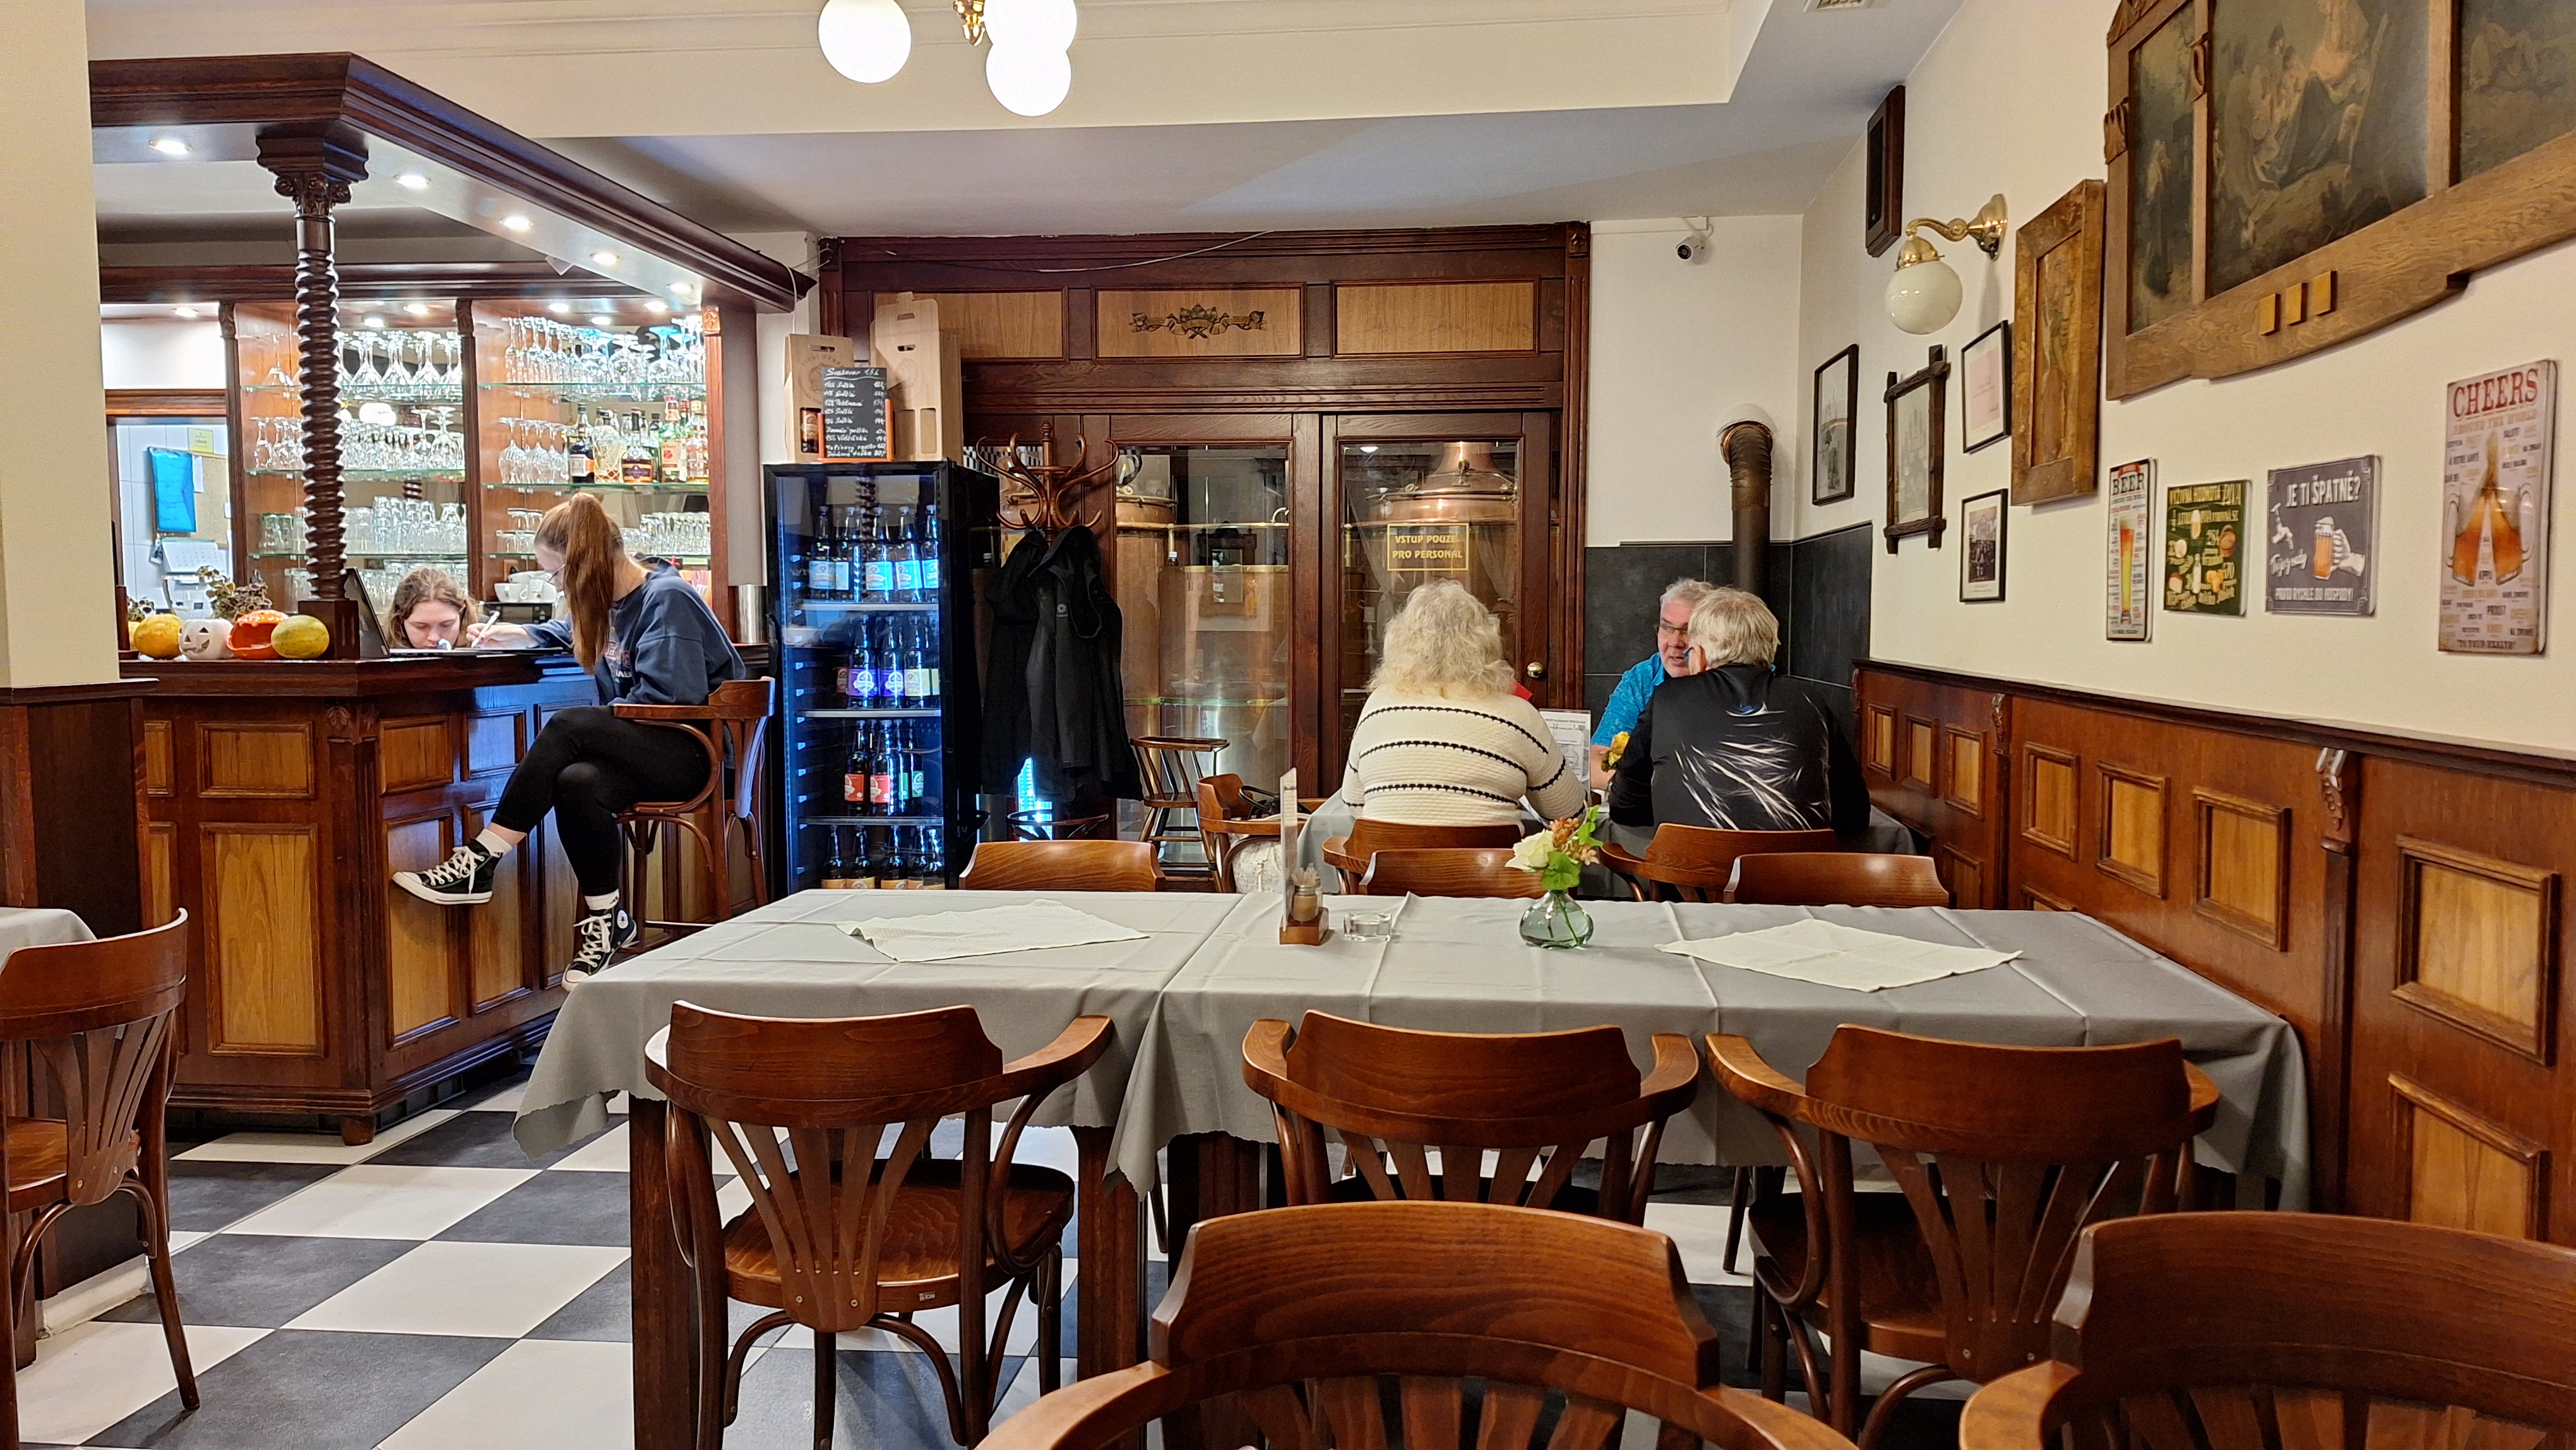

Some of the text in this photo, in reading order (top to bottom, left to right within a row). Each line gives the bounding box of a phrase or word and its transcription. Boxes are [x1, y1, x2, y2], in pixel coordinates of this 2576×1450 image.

[2454, 368, 2539, 417] CHEERS
[2111, 472, 2145, 496] BEER
[2222, 483, 2241, 505] PIVA
[2286, 469, 2361, 507] JE TI ŠPATNĚ?
[1395, 535, 1458, 544] VSTUP POUZE
[1392, 550, 1412, 560] PRO
